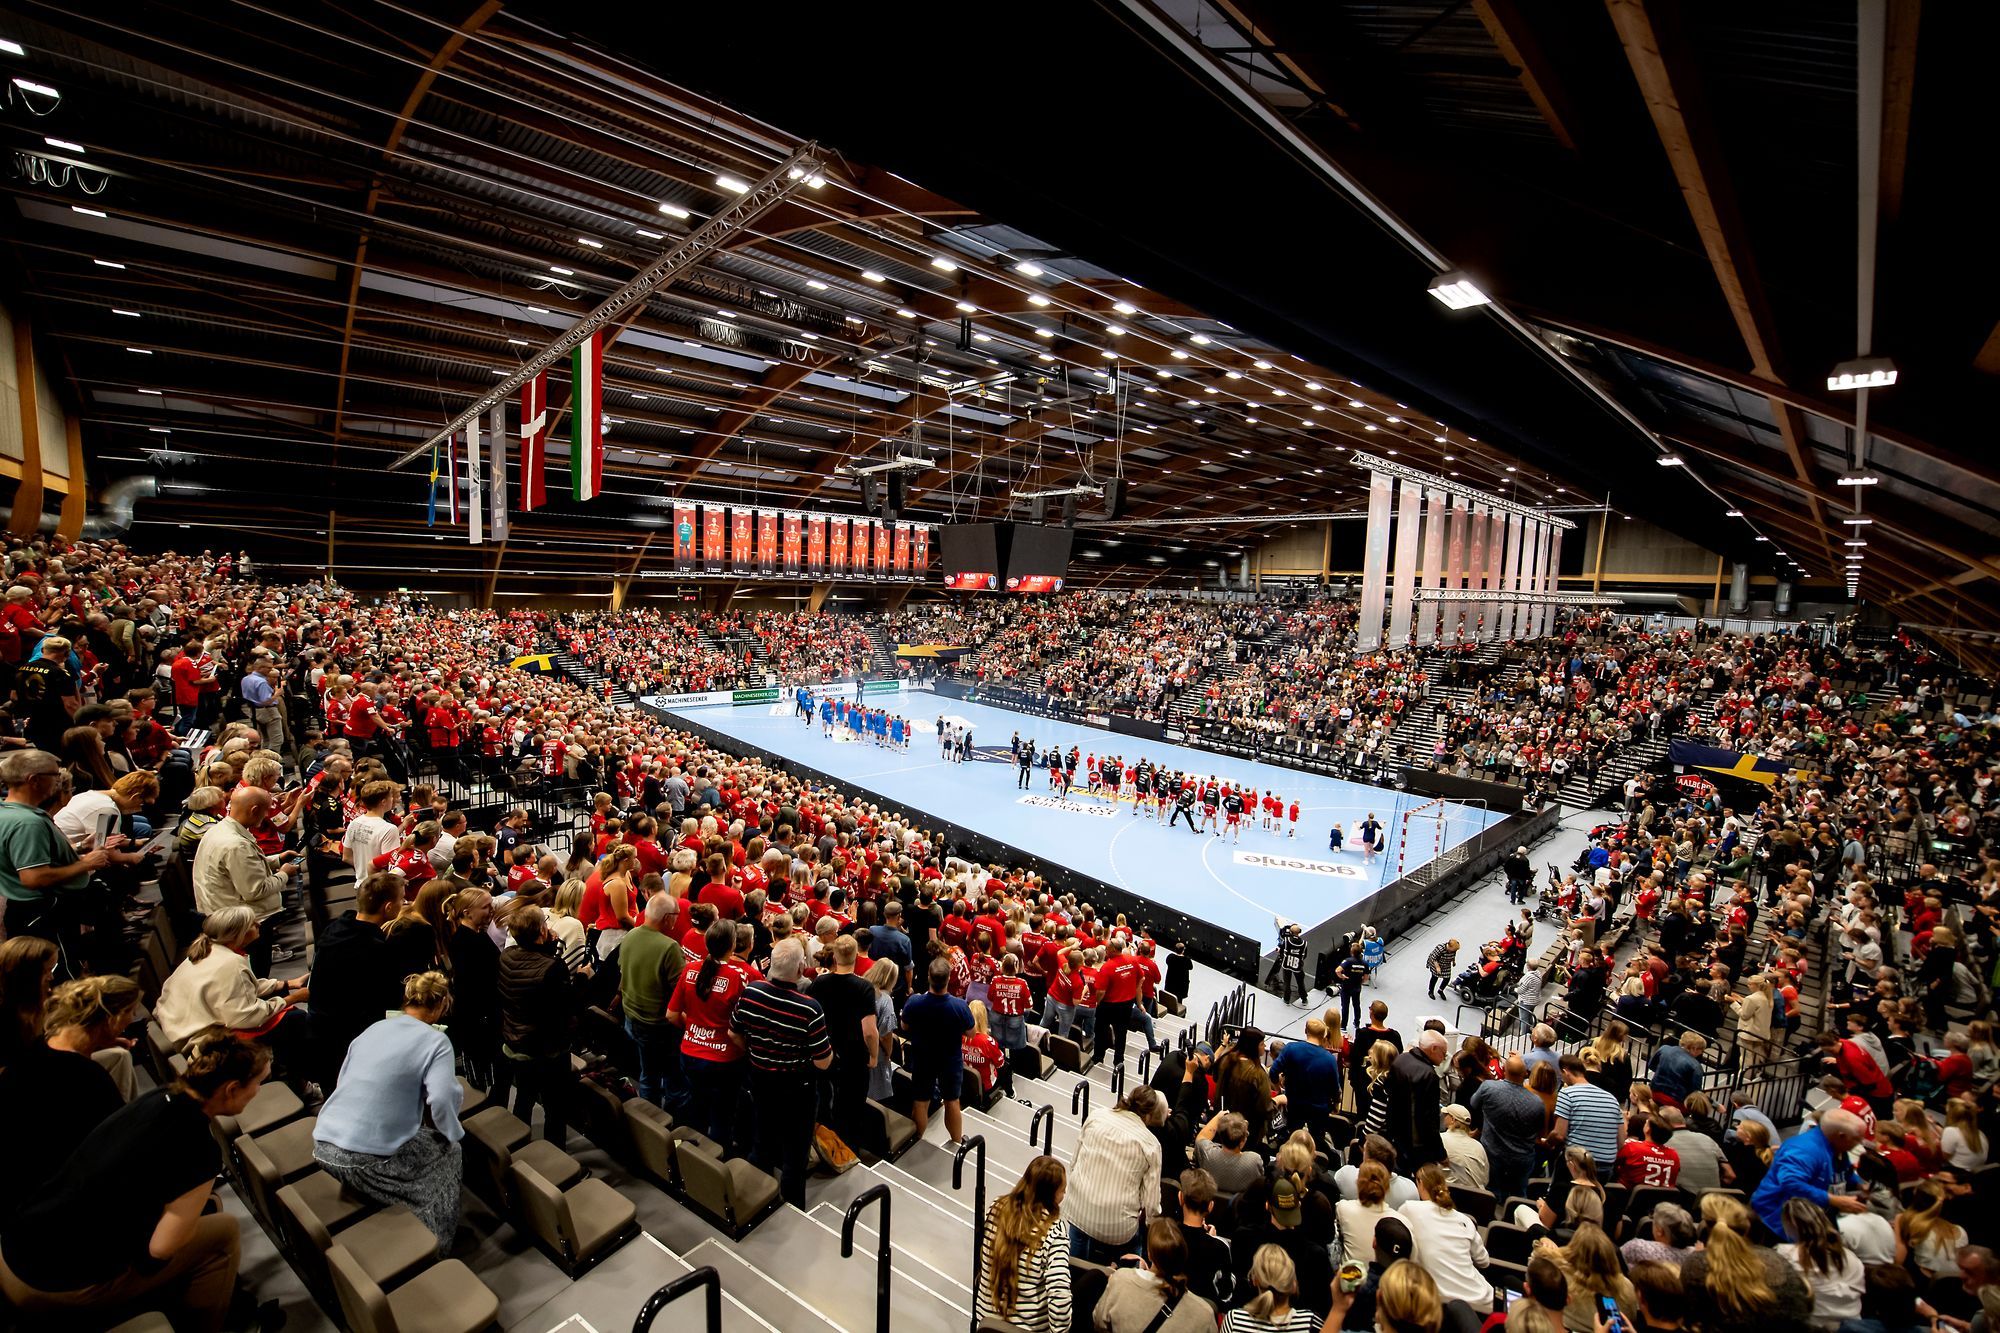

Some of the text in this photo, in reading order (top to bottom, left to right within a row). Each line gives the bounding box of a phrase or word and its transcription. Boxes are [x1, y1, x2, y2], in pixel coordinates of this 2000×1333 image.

[668, 696, 708, 704] MACHINESEEKER
[734, 691, 778, 699] MACHINESEEKER.COM
[1244, 856, 1356, 876] gorenje
[1286, 954, 1300, 969] HB
[715, 978, 728, 988] HUS
[1001, 998, 1018, 1015] 11
[690, 1024, 716, 1040] Hybel
[1644, 1164, 1672, 1187] 21
